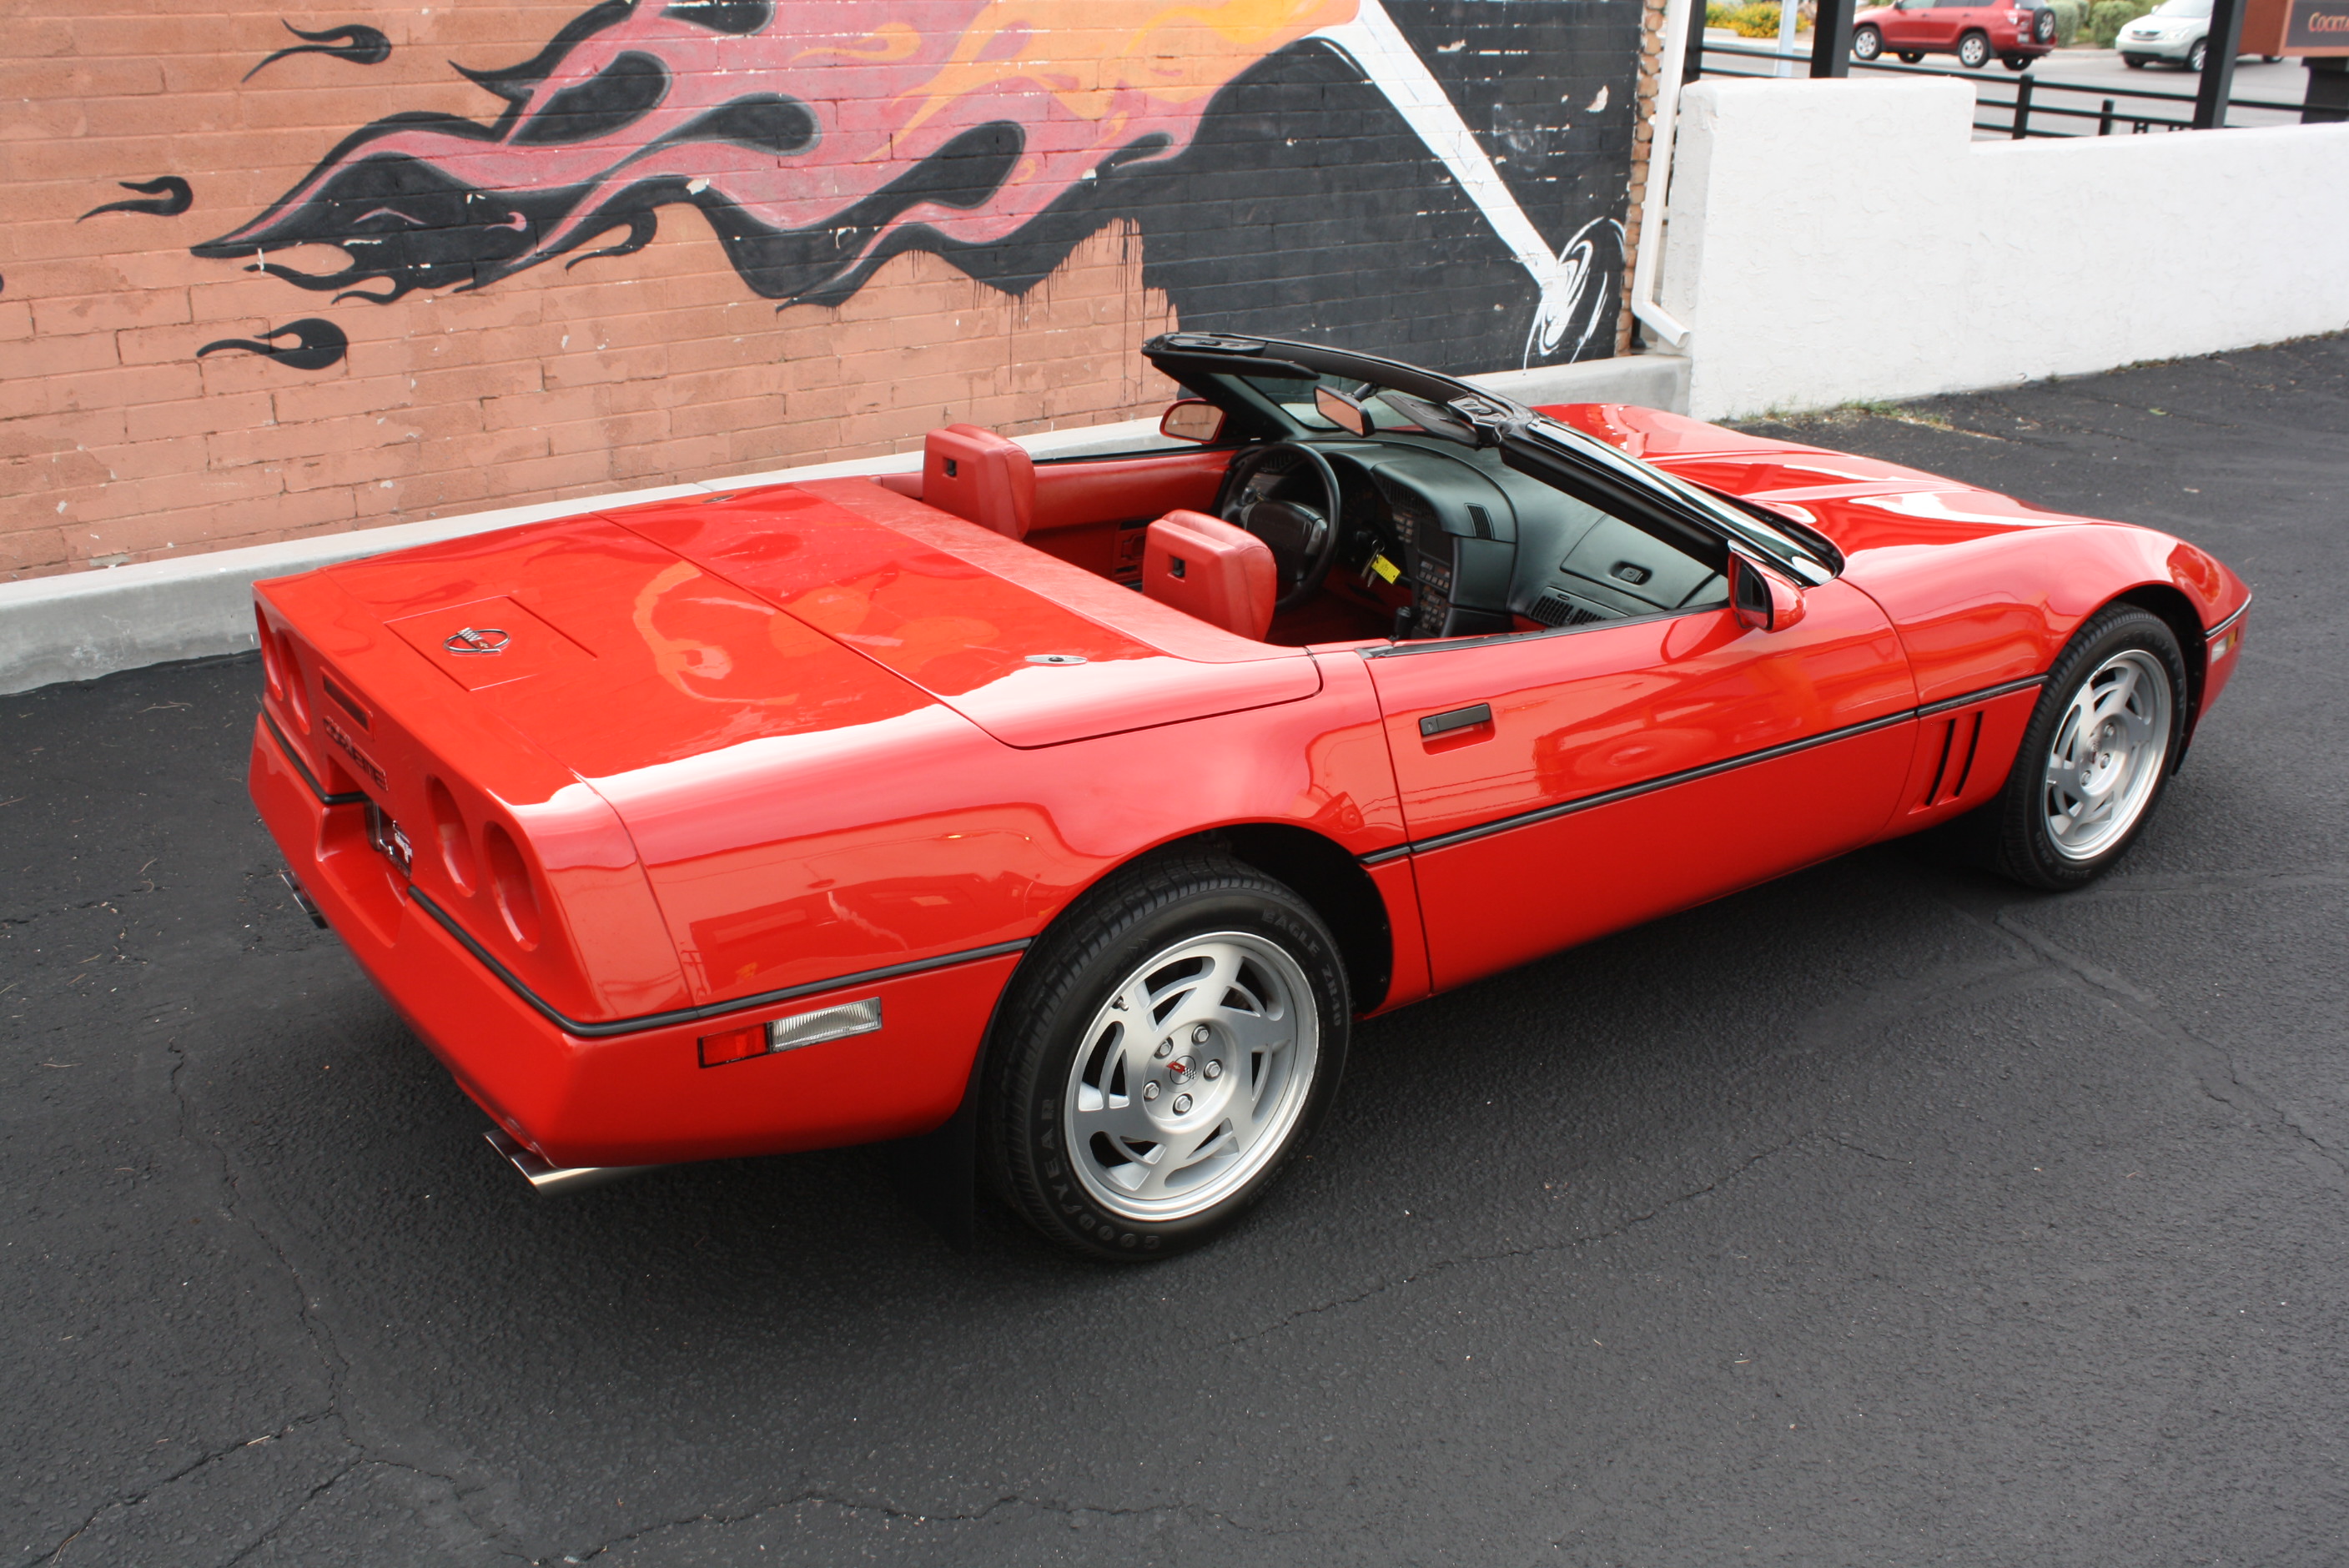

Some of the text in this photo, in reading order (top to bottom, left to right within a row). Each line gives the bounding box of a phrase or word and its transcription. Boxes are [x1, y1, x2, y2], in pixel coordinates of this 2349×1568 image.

[322, 716, 389, 792] CORVETTE
[1260, 907, 1321, 958] EAGLE
[1040, 1098, 1160, 1250] GOODYEAR
